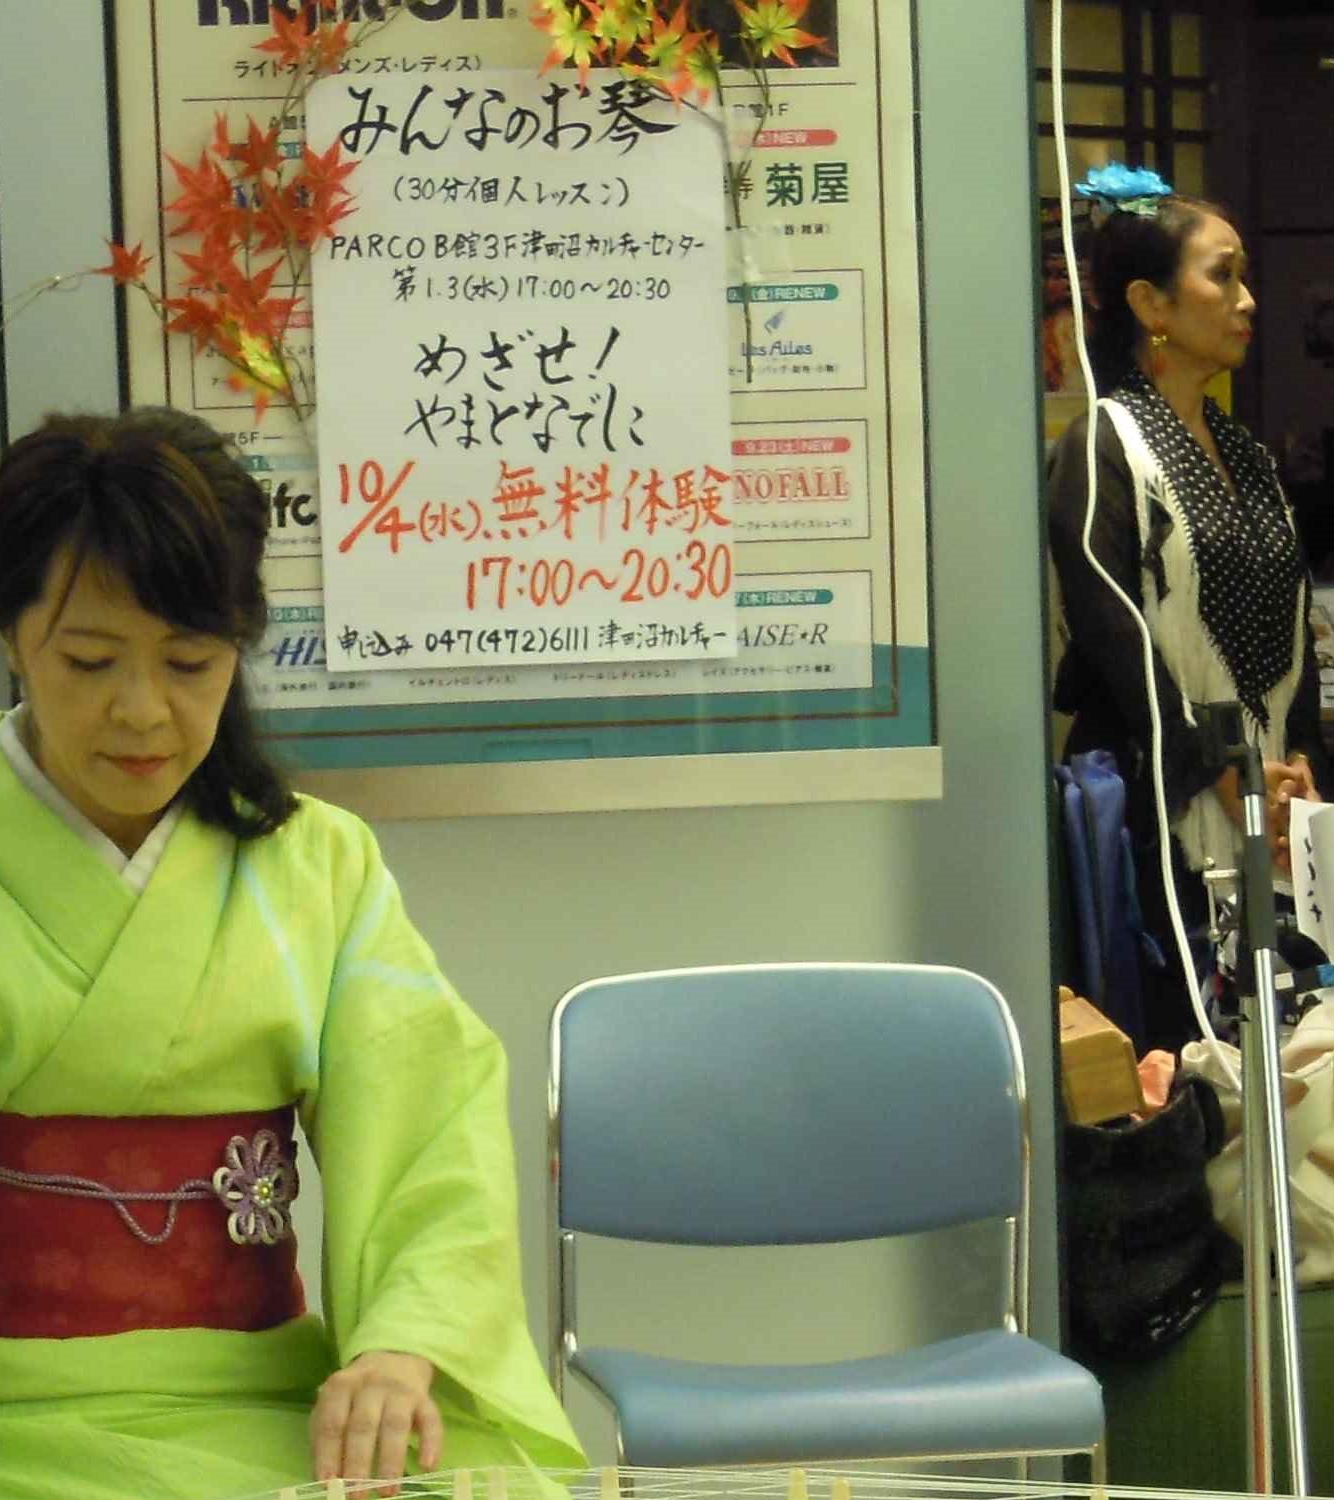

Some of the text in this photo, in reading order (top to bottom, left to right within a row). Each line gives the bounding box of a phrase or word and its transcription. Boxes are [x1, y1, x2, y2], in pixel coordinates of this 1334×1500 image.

[340, 79, 680, 155] みんなのお琴
[393, 175, 630, 207] (30分個人レッスン)
[765, 162, 850, 208] 菊屋
[330, 234, 425, 260] PARCO
[414, 326, 620, 391] めざせ!
[403, 383, 645, 453] やまとなでしこ
[269, 637, 327, 666] HI
[336, 624, 413, 659] 申し込み
[425, 625, 589, 654] 047(472)6111
